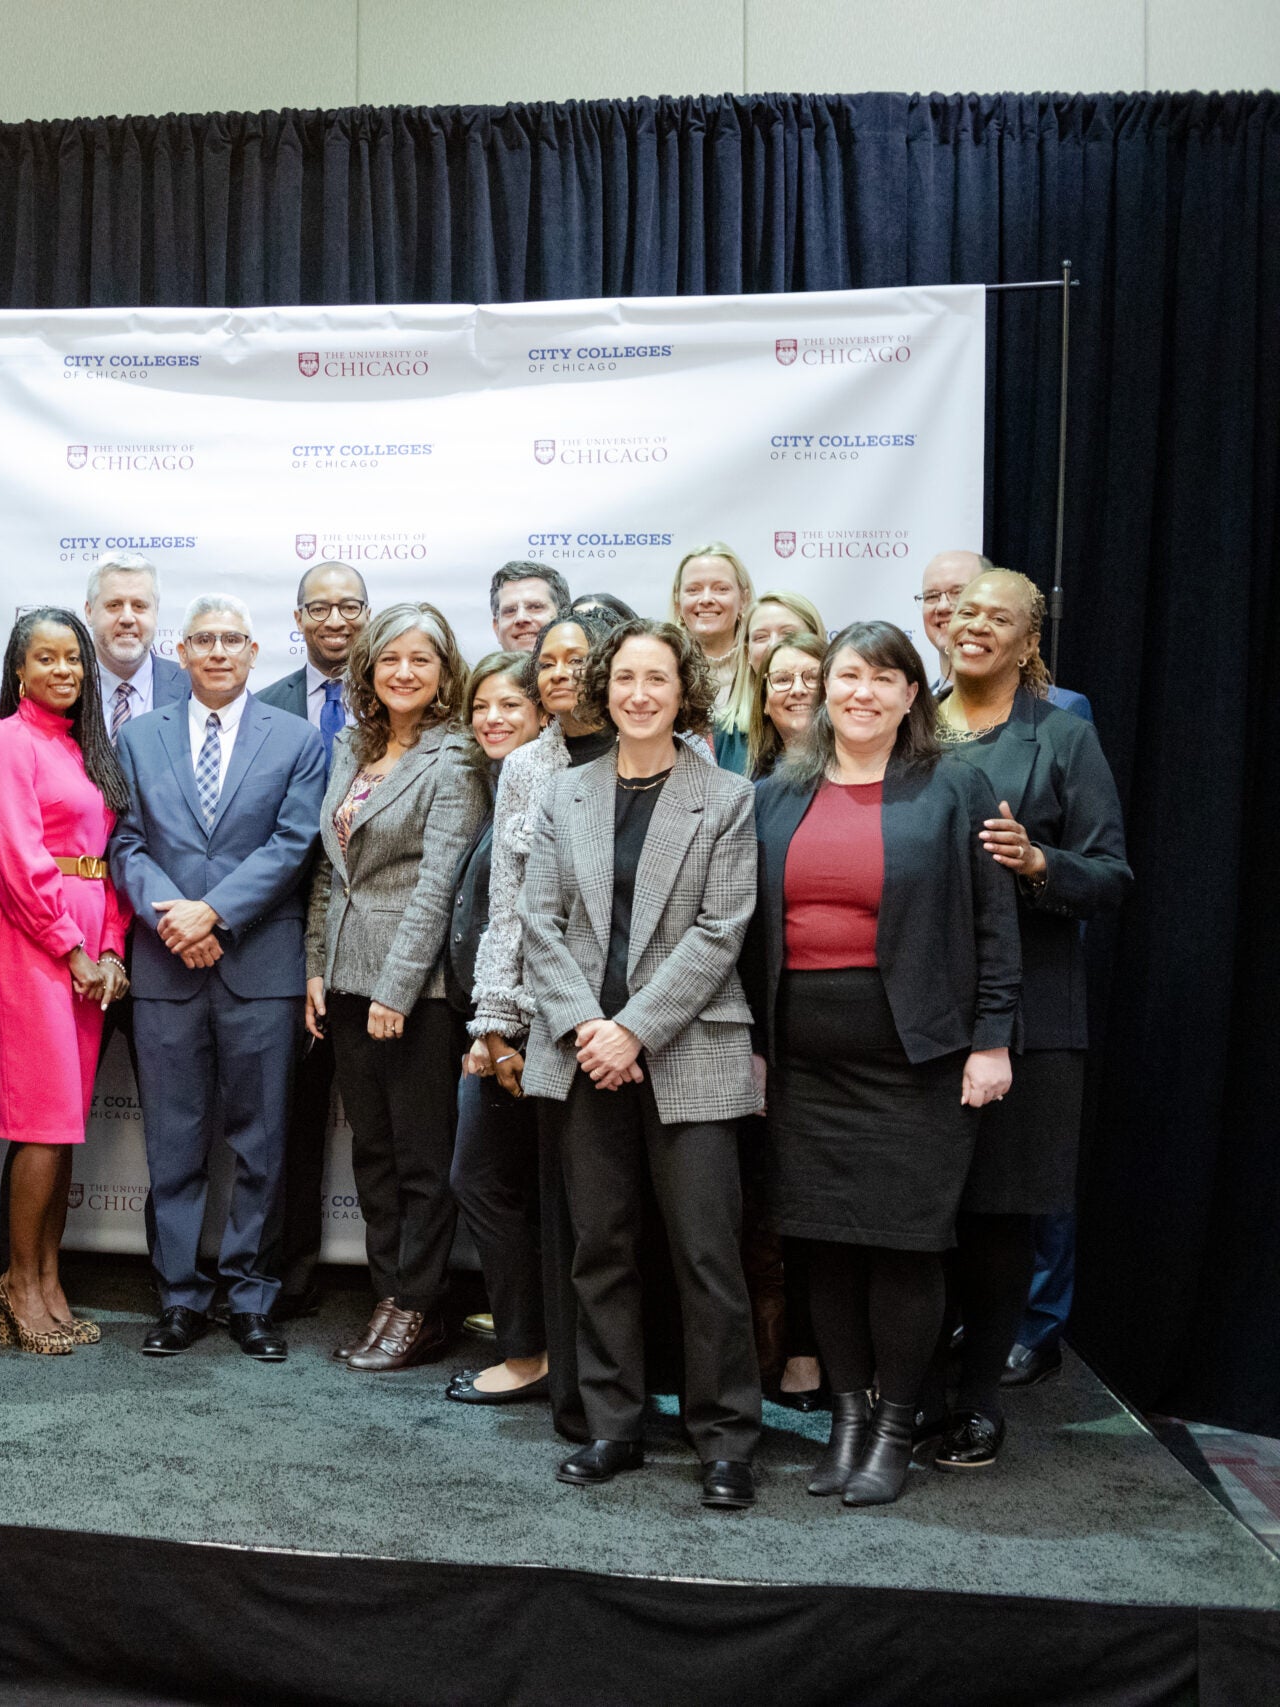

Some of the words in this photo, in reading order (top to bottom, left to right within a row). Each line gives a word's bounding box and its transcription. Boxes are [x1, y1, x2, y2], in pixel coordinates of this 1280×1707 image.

[803, 338, 827, 346] THE
[829, 335, 894, 345] UNIVERSITY
[897, 334, 912, 343] OF
[324, 351, 345, 359] THE
[349, 350, 412, 359] UNIVERSITY
[415, 350, 429, 358] OF
[528, 348, 572, 361] CITY
[577, 345, 672, 359] COLLEGES
[802, 346, 911, 365] CHICAGO
[64, 355, 105, 367] CITY
[109, 355, 200, 367] COLLEGES
[324, 361, 429, 377] CHICAGO
[528, 364, 545, 373] OF
[552, 362, 617, 373] CHICAGO
[63, 370, 78, 379] OF
[86, 370, 148, 379] CHICAGO
[562, 438, 581, 446] THE
[586, 436, 650, 446] UNIVERSITY
[654, 436, 667, 444] OF
[771, 435, 814, 448] CITY
[819, 434, 915, 448] COLLEGES
[94, 445, 113, 453] THE
[117, 444, 178, 453] UNIVERSITY
[181, 444, 195, 452] OF
[292, 445, 335, 457] CITY
[340, 444, 433, 456] COLLEGES
[560, 446, 668, 465] CHICAGO
[770, 451, 787, 460] OF
[794, 451, 859, 460] CHICAGO
[92, 455, 194, 471] CHICAGO
[291, 460, 309, 469] OF
[315, 459, 378, 469] CHICAGO
[323, 533, 342, 541] THE
[347, 533, 410, 541] UNIVERSITY
[413, 532, 426, 540] OF
[528, 534, 572, 546] CITY
[577, 533, 672, 546] COLLEGES
[802, 531, 823, 539] THE
[828, 530, 891, 539] UNIVERSITY
[895, 530, 909, 539] OF
[59, 537, 101, 549] CITY
[105, 536, 196, 549] COLLEGES
[321, 544, 427, 560] CHICAGO
[528, 550, 545, 559] OF
[552, 549, 617, 559] CHICAGO
[801, 542, 909, 559] CHICAGO
[59, 553, 75, 561] OF
[289, 646, 306, 655] OF
[90, 1110, 141, 1121] HICAGO
[89, 1184, 110, 1192] THE
[88, 1194, 143, 1212] CHIC
